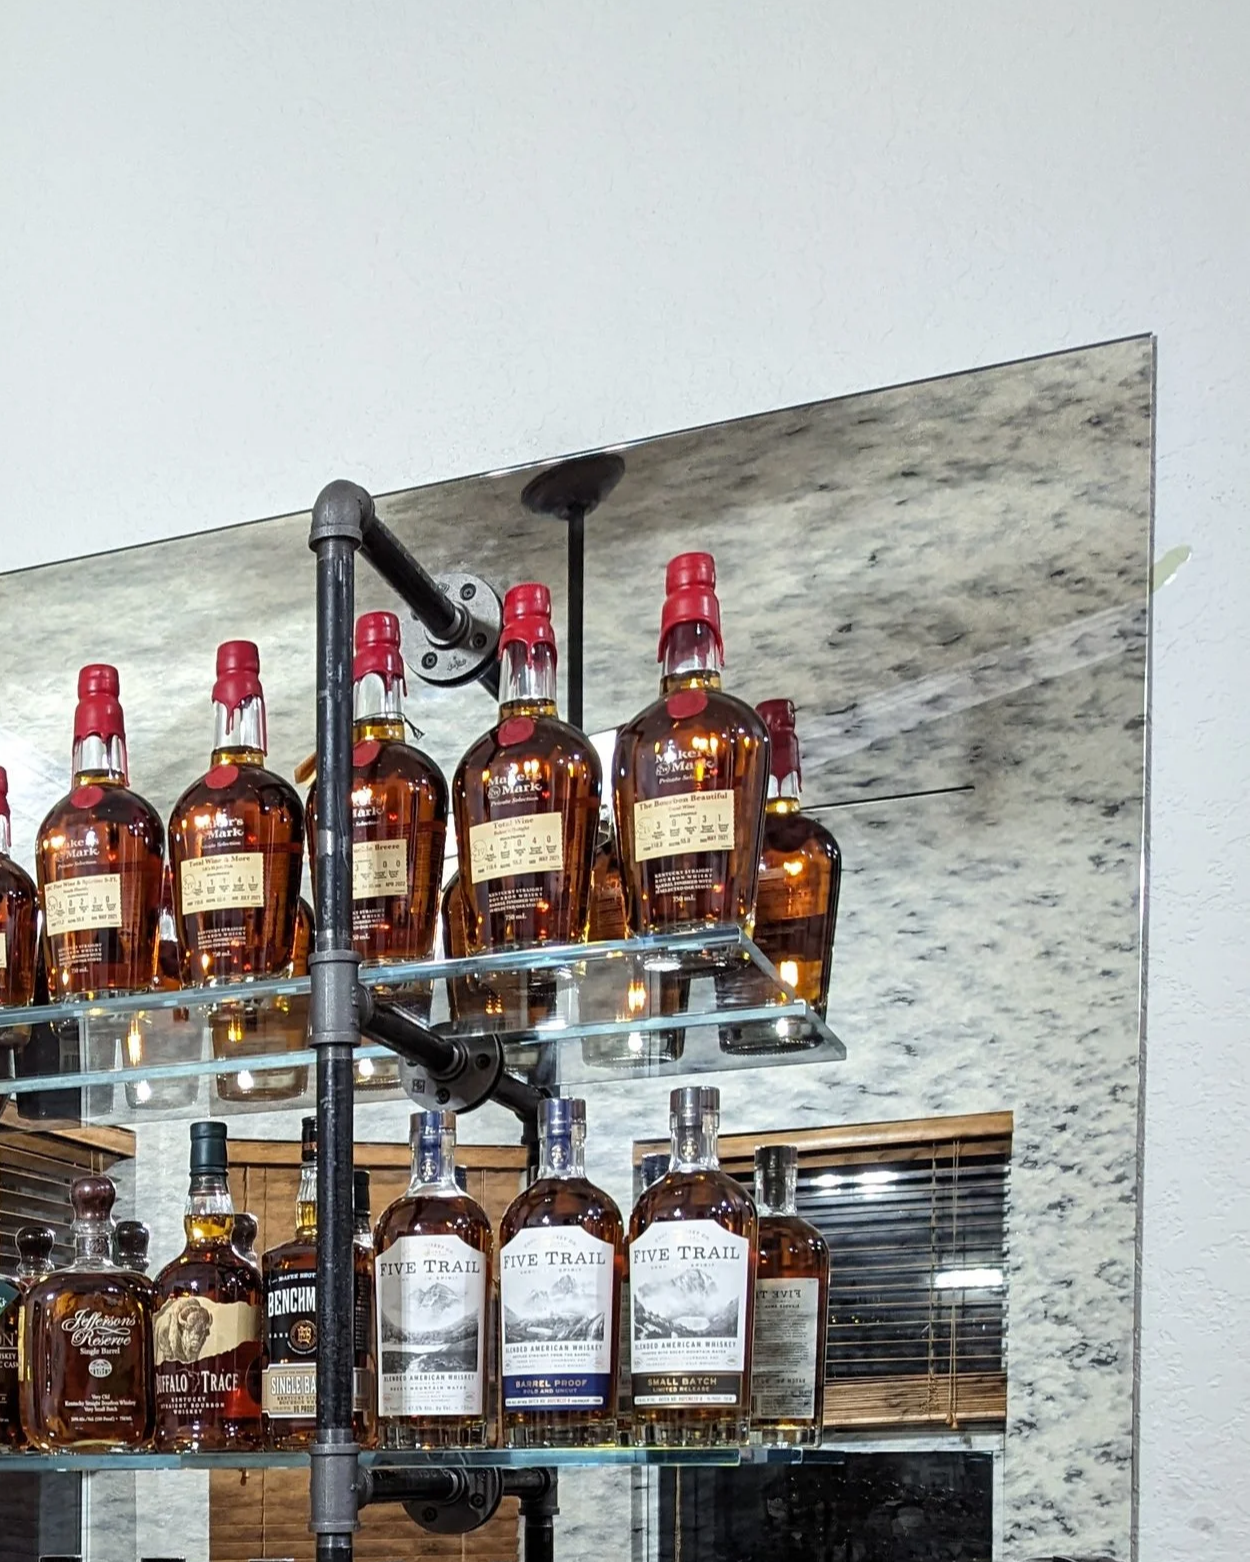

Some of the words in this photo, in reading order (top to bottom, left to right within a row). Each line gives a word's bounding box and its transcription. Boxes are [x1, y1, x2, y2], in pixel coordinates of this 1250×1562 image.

[501, 783, 542, 796] Mark
[639, 802, 652, 811] The
[690, 791, 728, 801] Beautiful
[189, 860, 204, 868] Total
[231, 855, 250, 863] More
[504, 1254, 538, 1269] FIVE
[545, 1251, 606, 1265] TRAIL
[634, 1248, 670, 1264] FIVE
[677, 1246, 740, 1261] TRAIL
[380, 1261, 416, 1277] FIVE
[423, 1259, 480, 1274] TRAIL
[268, 1286, 316, 1318] BENCHM
[61, 1307, 136, 1332] Jefferson's
[71, 1328, 132, 1346] Reserve
[661, 1341, 702, 1349] AMERICAN
[80, 1347, 100, 1356] Single
[530, 1344, 569, 1352] AMERICAN
[201, 1370, 239, 1394] TRACE
[271, 1376, 301, 1395] SINGLE
[515, 1379, 551, 1389] BARREL
[554, 1379, 588, 1387] PROOF
[647, 1377, 679, 1387] SMALL
[682, 1376, 717, 1386] BATCH
